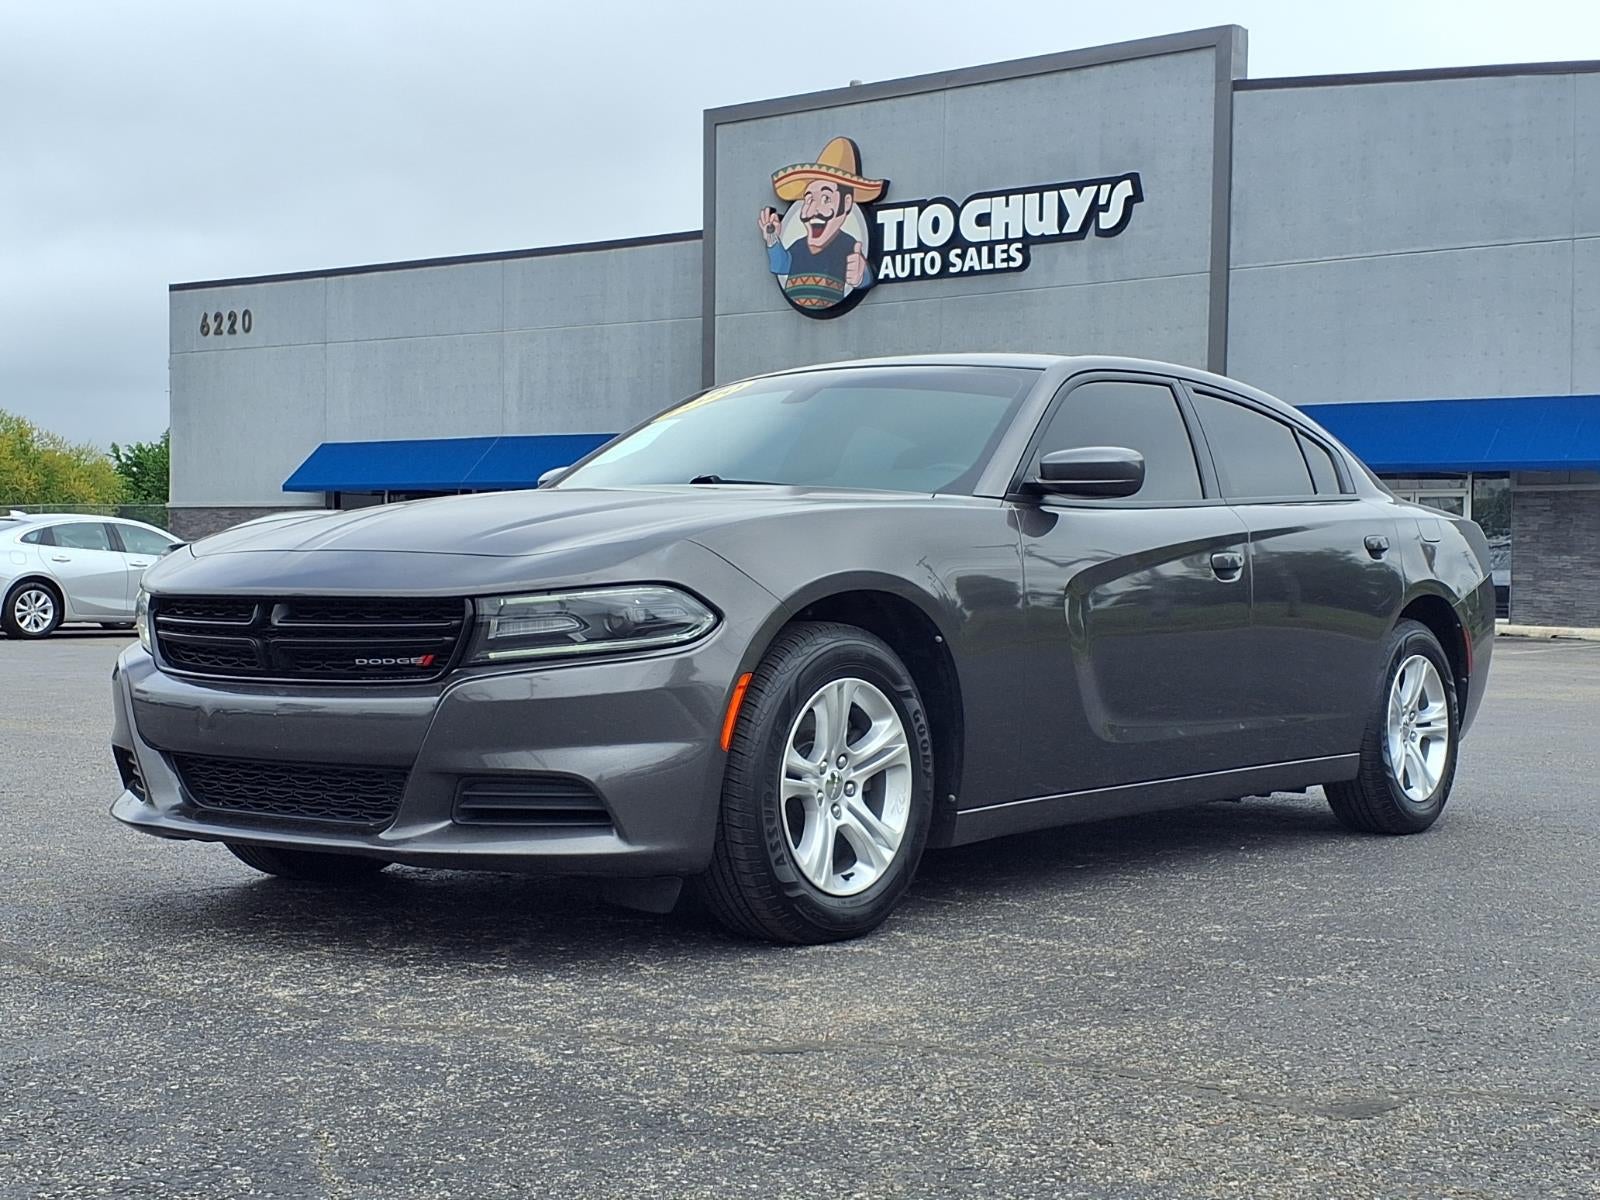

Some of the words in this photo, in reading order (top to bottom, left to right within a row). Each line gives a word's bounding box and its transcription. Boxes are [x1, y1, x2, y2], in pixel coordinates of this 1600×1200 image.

[876, 203, 955, 252] TIO
[959, 179, 1133, 243] CHUY'S
[878, 250, 942, 280] AUTO
[948, 242, 1023, 273] SALES
[200, 308, 252, 337] 6220
[355, 657, 424, 665] DODGE
